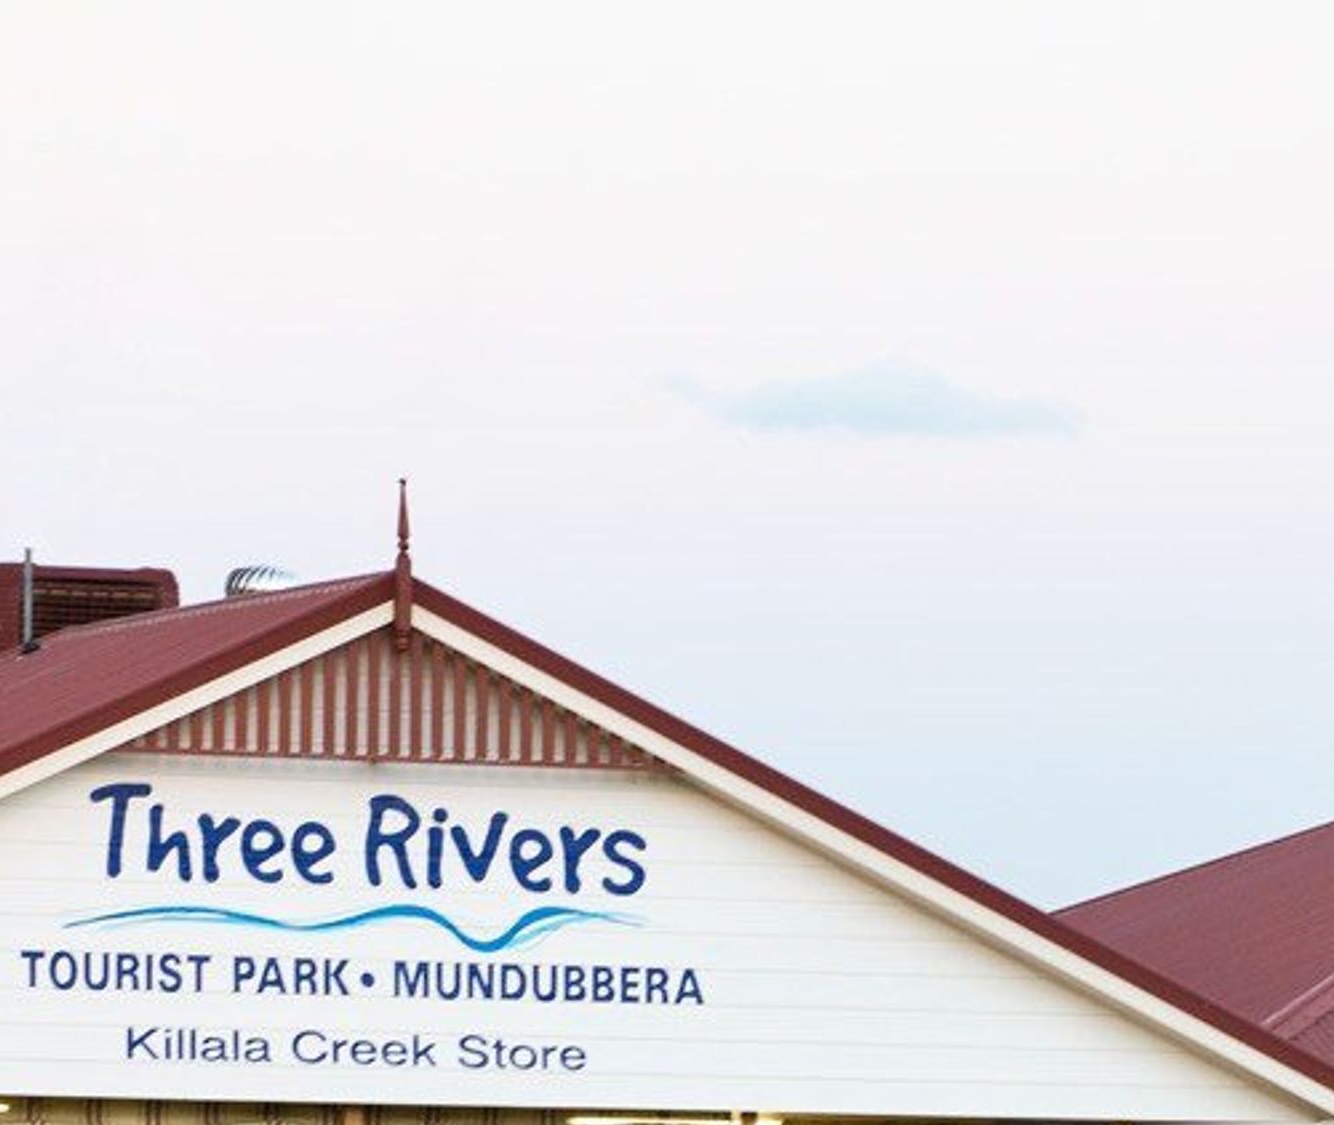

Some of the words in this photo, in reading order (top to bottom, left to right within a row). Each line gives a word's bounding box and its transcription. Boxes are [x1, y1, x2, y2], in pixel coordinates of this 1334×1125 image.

[90, 783, 336, 884] Three
[365, 794, 647, 896] Rivers
[21, 951, 211, 993] TOURIST
[393, 960, 704, 1005] MUNDUBBERA
[127, 1026, 271, 1064] Killala
[292, 1030, 437, 1066] Creek
[458, 1034, 587, 1071] Store
